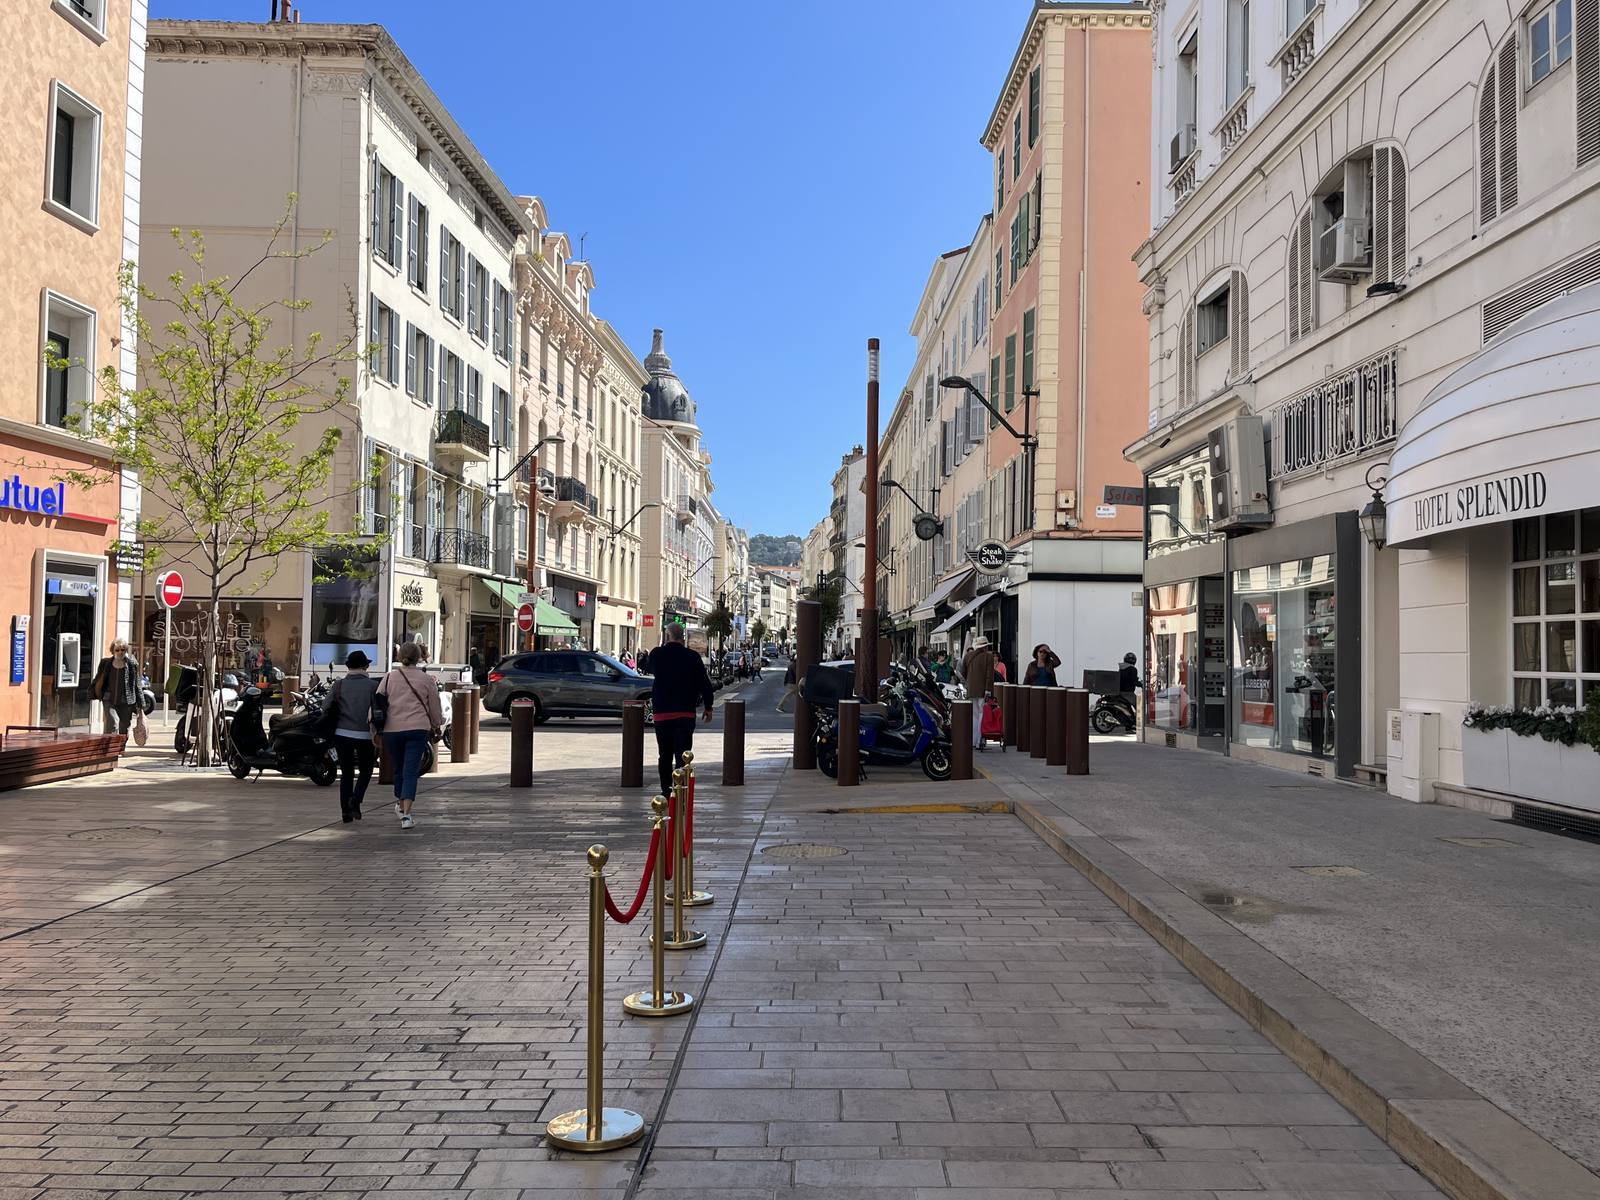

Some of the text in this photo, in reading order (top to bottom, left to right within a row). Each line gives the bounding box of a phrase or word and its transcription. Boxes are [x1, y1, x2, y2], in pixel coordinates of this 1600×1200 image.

[1415, 472, 1546, 531] HOTEL SPLENDID
[982, 547, 1002, 555] Steak
[981, 557, 1003, 565] Shake
